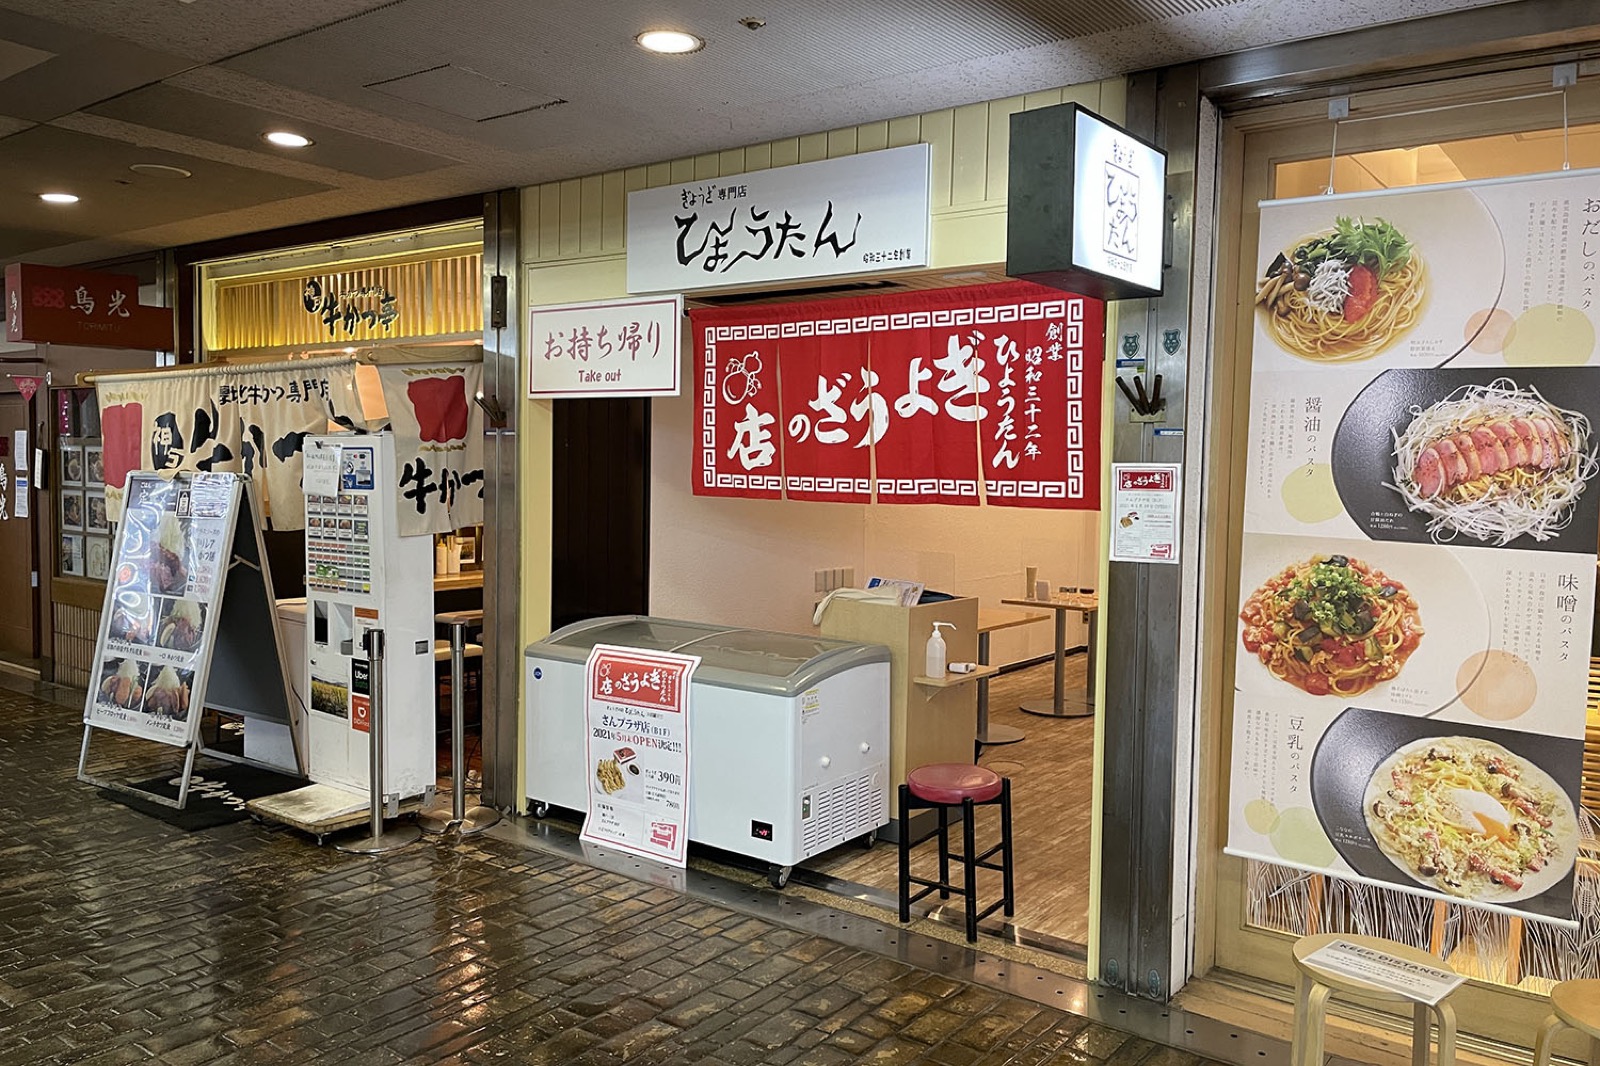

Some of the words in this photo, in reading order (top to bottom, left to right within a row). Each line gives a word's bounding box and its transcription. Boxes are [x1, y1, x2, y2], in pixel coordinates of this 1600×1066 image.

[674, 200, 862, 274] ひょうたん
[321, 291, 399, 337] 牛かつ亭
[543, 319, 662, 361] お持ち帰り
[1045, 321, 1064, 362] 創業
[578, 368, 602, 384] Take
[605, 368, 622, 383] out
[992, 334, 1021, 470] ひょうたん
[1025, 346, 1042, 461] 昭和三十二年
[1304, 396, 1322, 478] 醤油のパスタ
[1557, 573, 1579, 664] 味噌のパスタ
[354, 670, 369, 680] Uber
[1287, 715, 1304, 793] 豆乳のパスタ
[1339, 943, 1375, 955] KEEP
[1378, 954, 1450, 980] DISTANCE
